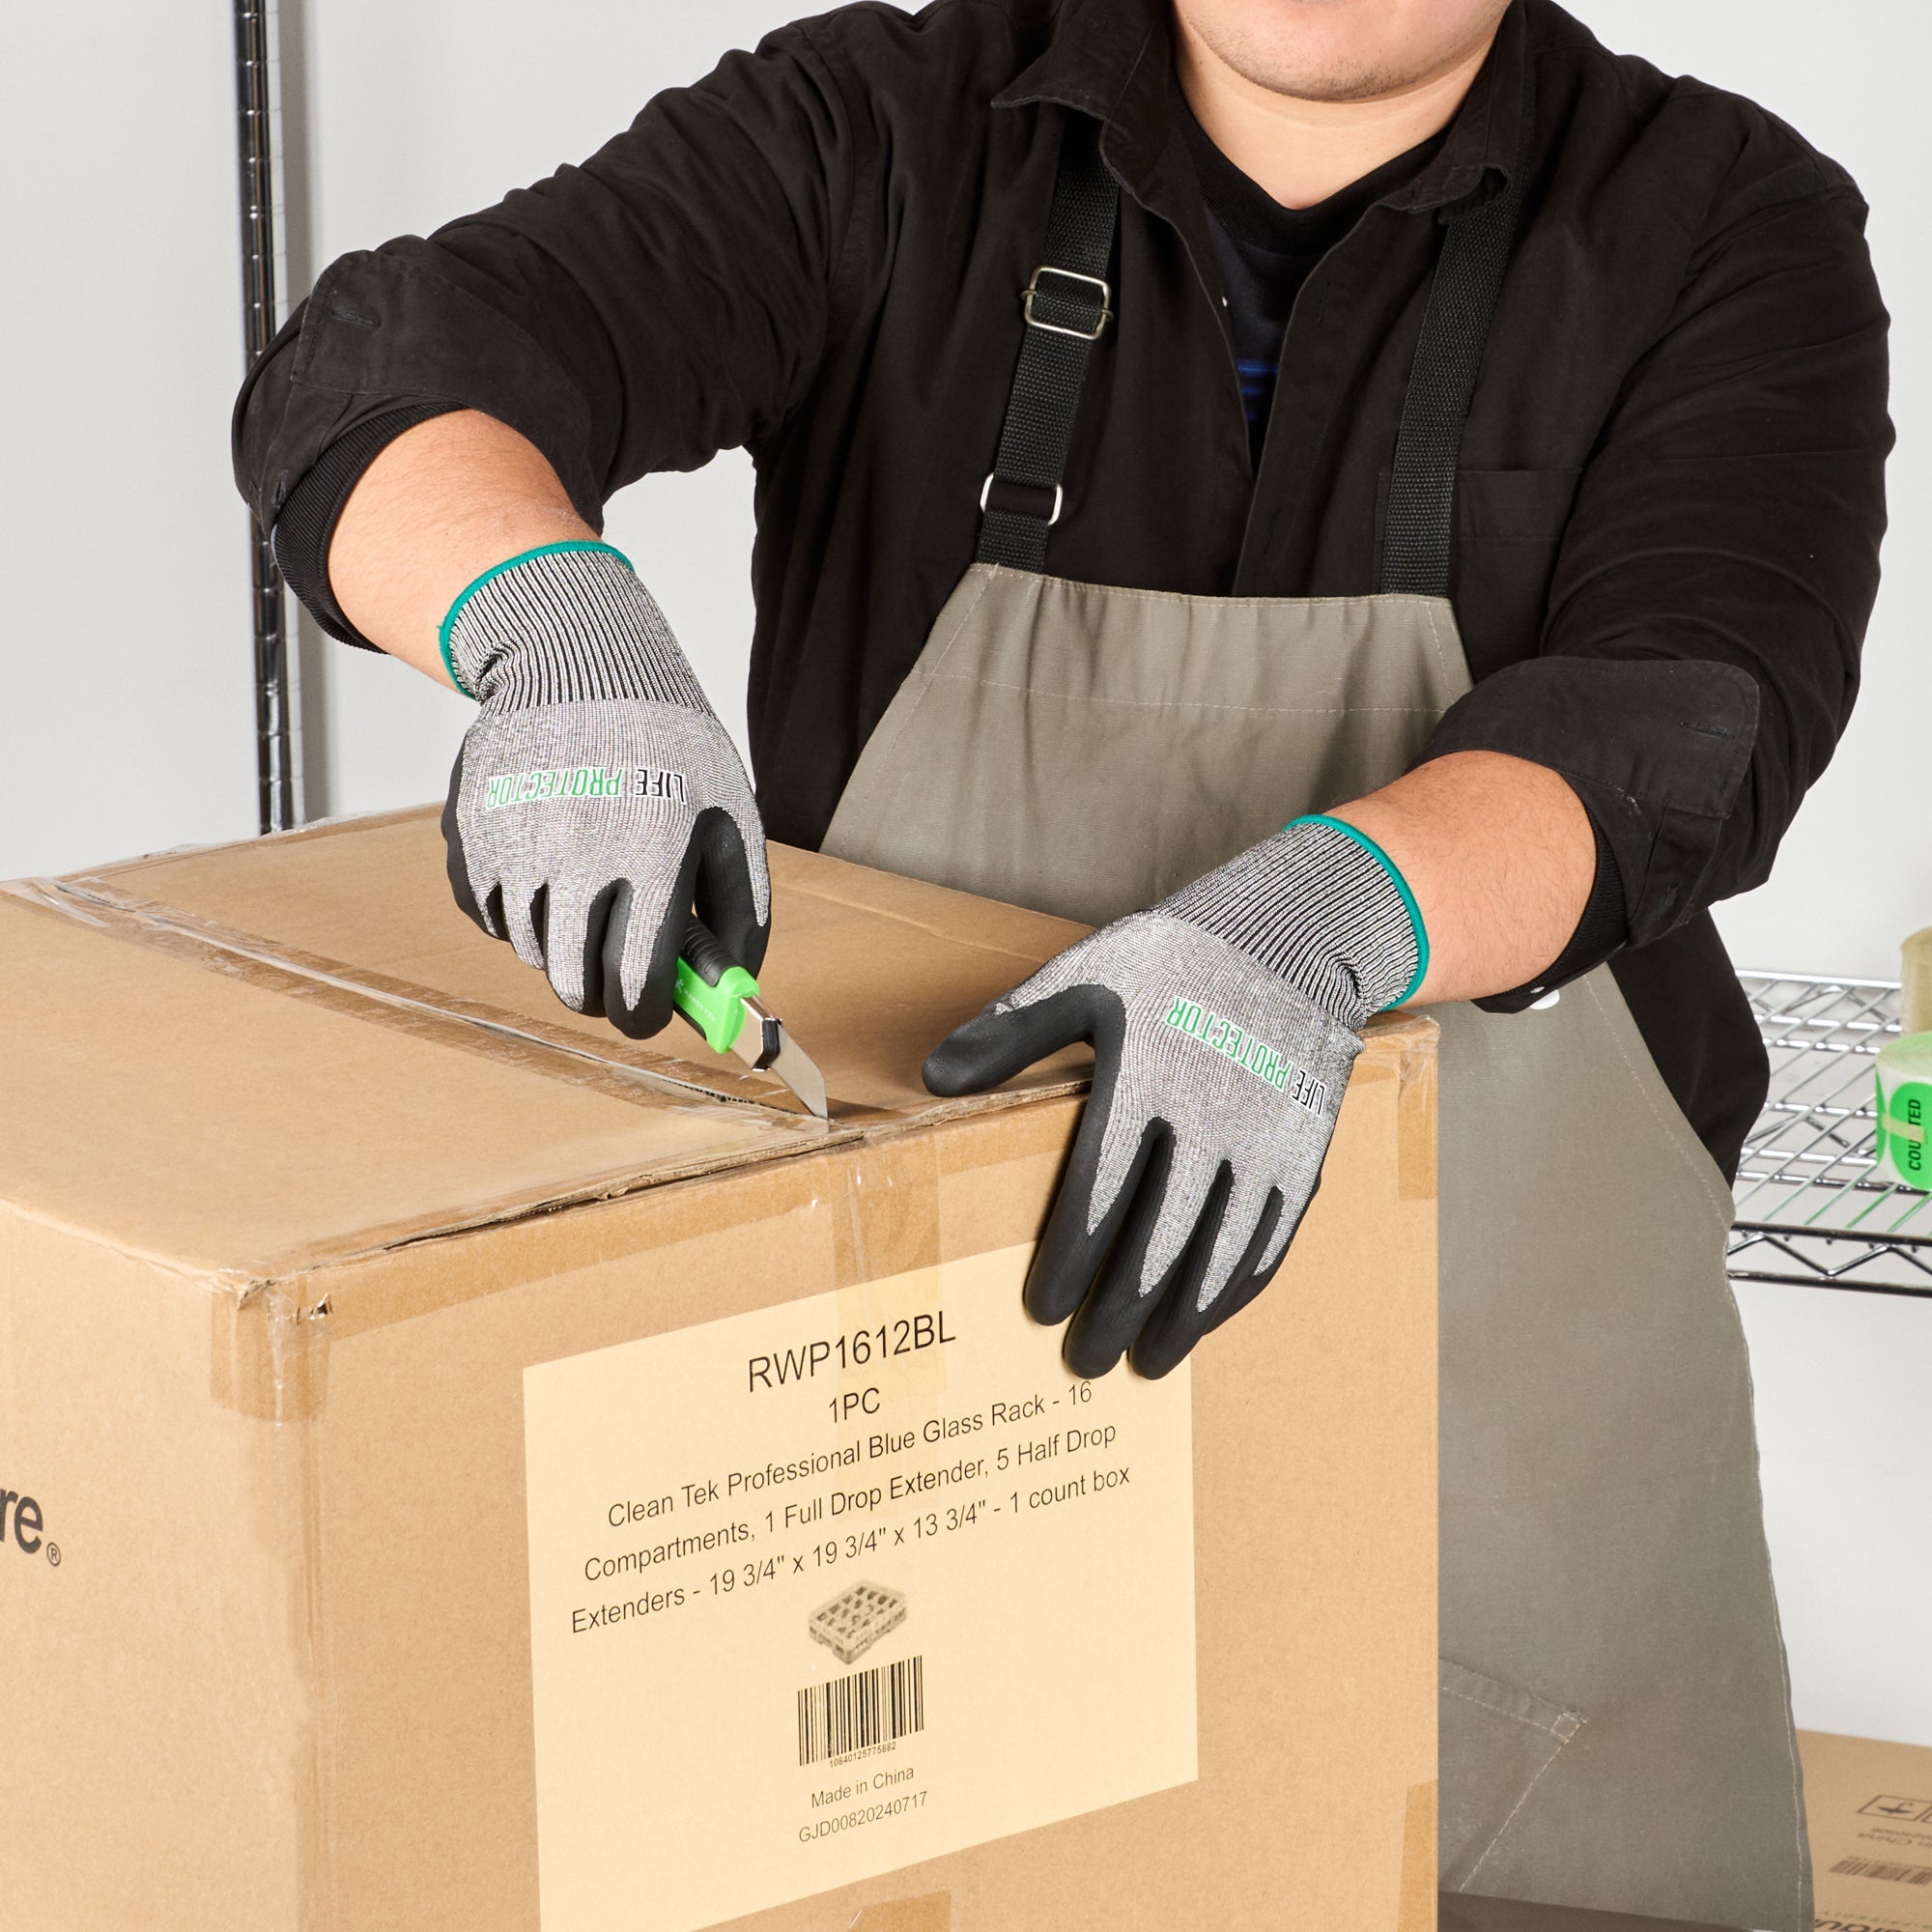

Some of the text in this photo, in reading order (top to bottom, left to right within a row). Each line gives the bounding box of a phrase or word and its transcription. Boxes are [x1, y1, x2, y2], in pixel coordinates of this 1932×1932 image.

[486, 768, 686, 809] LIFE PROTECTOR
[1166, 997, 1325, 1116] LIFE PROTECTOR
[1908, 1098, 1922, 1172] COUTED
[748, 1310, 956, 1393] RWP1612BL
[828, 1386, 881, 1424] 1PC
[608, 1495, 674, 1527] Clean
[681, 1480, 720, 1508] Tek
[727, 1439, 861, 1496] Professional
[869, 1433, 916, 1459] Blue
[923, 1413, 983, 1443] Glass
[991, 1394, 1046, 1426] Rack
[1068, 1380, 1093, 1406] 16
[583, 1424, 1117, 1581] Compartments, 1 Full Drop Extender, 5 Half Drop
[572, 1587, 686, 1634] Extenders
[709, 1568, 735, 1596] 19
[743, 1554, 785, 1587] 3/4"
[792, 1554, 805, 1575] x
[812, 1541, 838, 1567] 19
[845, 1525, 887, 1558] 3/4"
[894, 1526, 905, 1546] x
[913, 1513, 939, 1539] 13
[946, 1499, 986, 1531] 3/4"
[1009, 1491, 1019, 1514] 1
[1029, 1473, 1087, 1509] count
[1093, 1466, 1130, 1492] box
[810, 1767, 915, 1808] Made in China
[829, 1741, 897, 1768] 10840125775882
[798, 1790, 928, 1843] GJD00820240717
